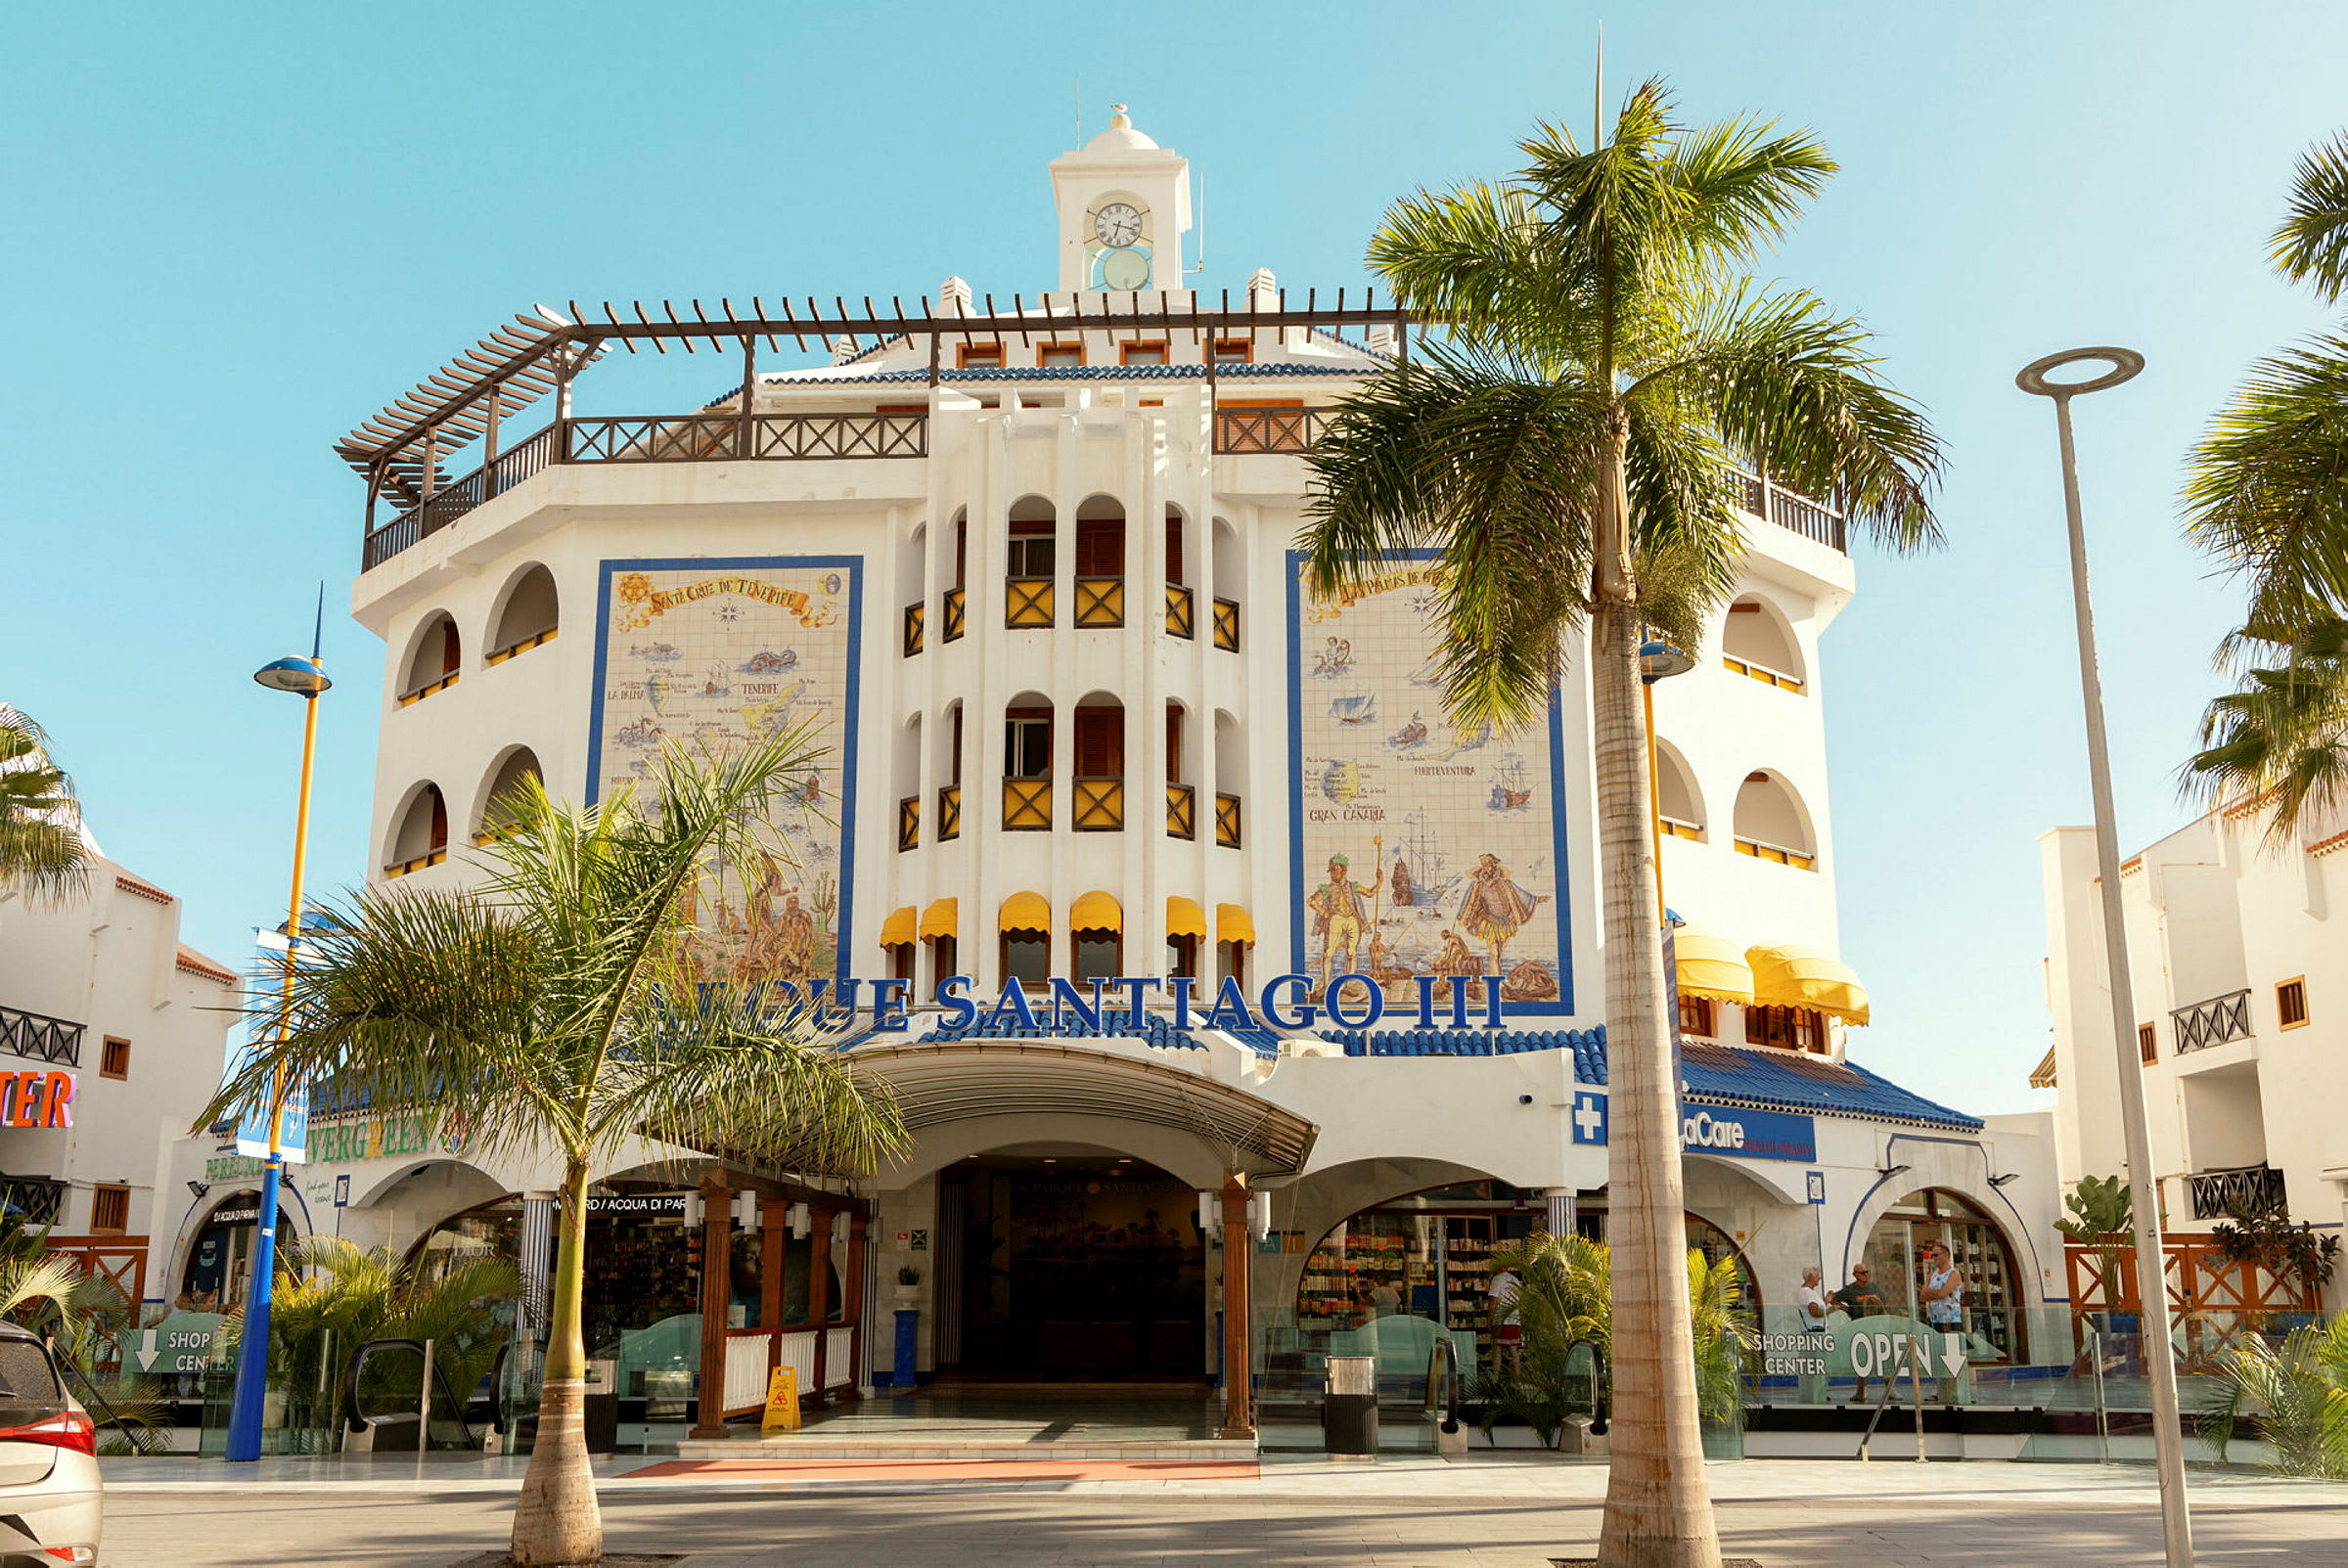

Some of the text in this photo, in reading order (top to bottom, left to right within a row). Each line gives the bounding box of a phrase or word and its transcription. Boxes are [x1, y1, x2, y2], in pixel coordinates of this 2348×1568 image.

[718, 580, 734, 593] DE
[738, 579, 796, 606] TENERIFE
[742, 683, 779, 694] TENERIFE
[1309, 809, 1386, 823] GRAN CANARIA
[935, 973, 1385, 1035] SANTIAGO
[1412, 974, 1508, 1031] III
[308, 1113, 431, 1163] VERGREEN
[608, 1199, 648, 1211] ACQUA
[651, 1199, 661, 1211] DI
[664, 1199, 686, 1211] PAR
[453, 1243, 495, 1258] DIOR
[1754, 1333, 1835, 1352] SHOPPING
[1849, 1331, 1933, 1378] OPEN
[1765, 1357, 1827, 1375] CENTER
